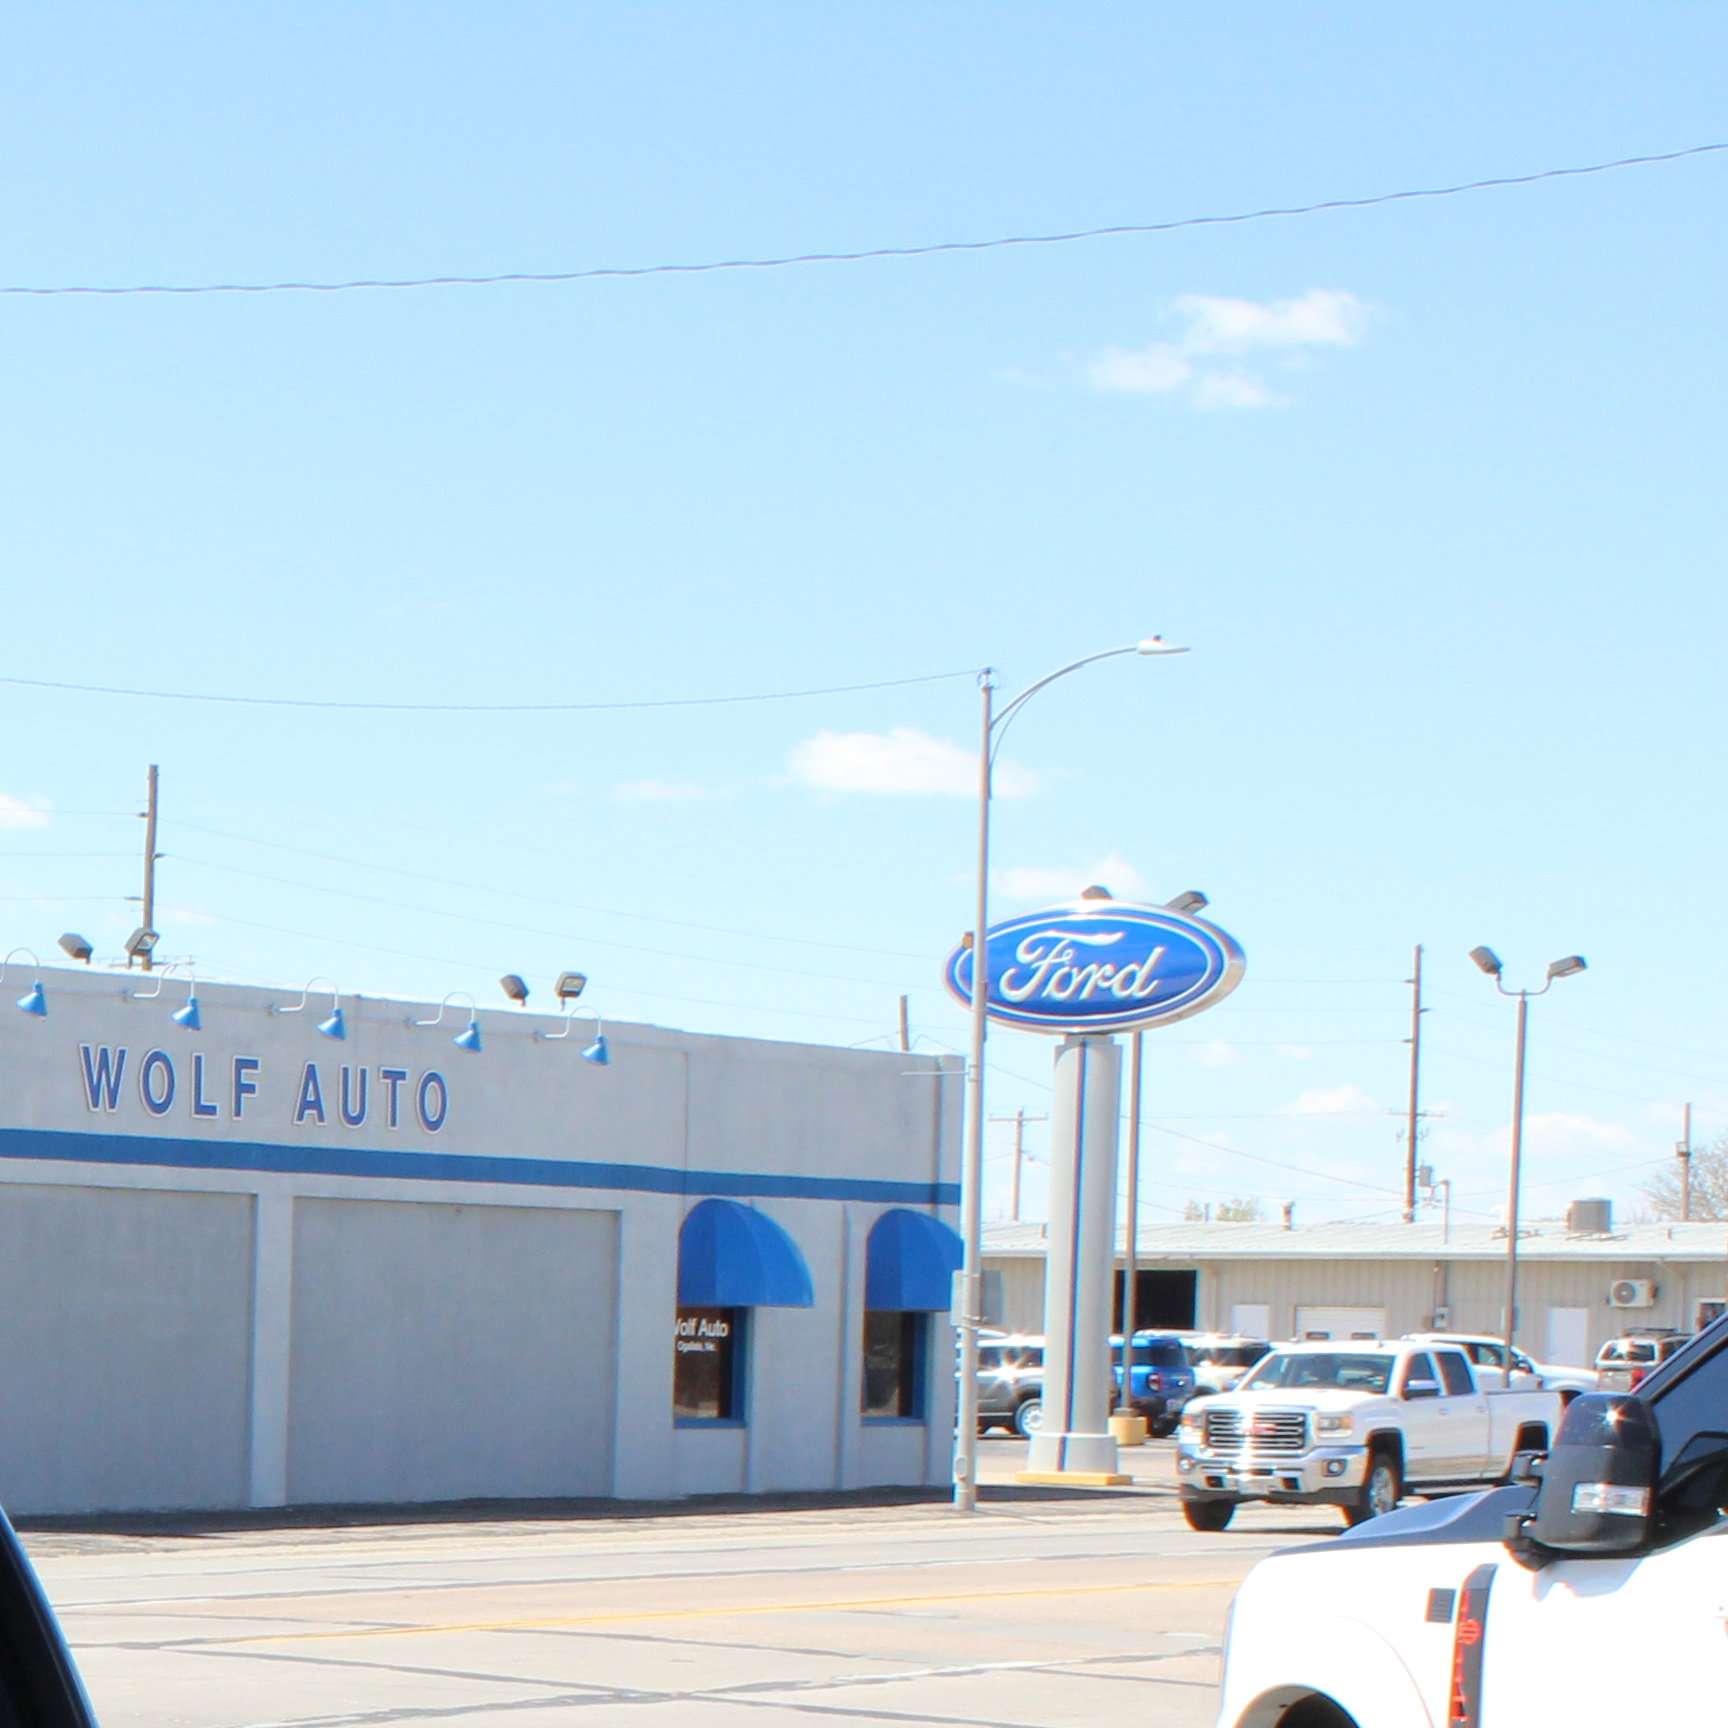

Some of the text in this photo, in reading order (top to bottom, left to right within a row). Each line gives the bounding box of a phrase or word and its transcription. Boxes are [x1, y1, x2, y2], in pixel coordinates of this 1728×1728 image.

[998, 929, 1166, 1003] Ford
[79, 1043, 450, 1134] WOLF AUTO
[697, 1318, 730, 1337] Auto
